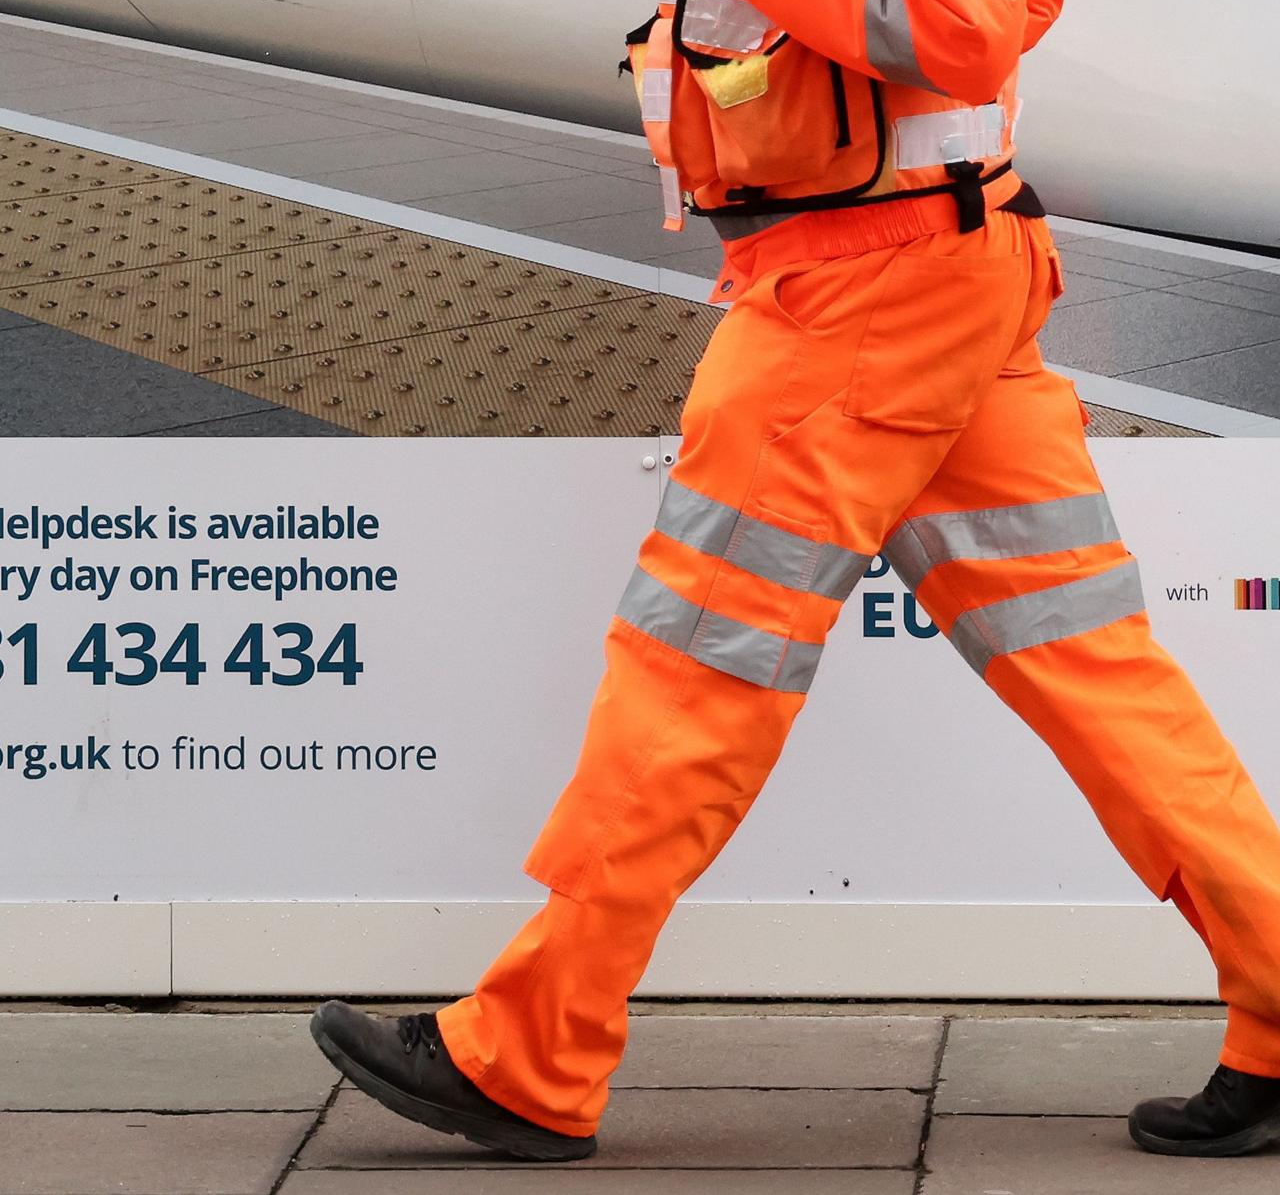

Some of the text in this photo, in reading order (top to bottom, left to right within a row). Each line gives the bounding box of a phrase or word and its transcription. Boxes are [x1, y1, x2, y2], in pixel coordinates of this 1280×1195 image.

[169, 506, 197, 540] is
[207, 506, 379, 540] available
[50, 557, 120, 601] day
[129, 565, 178, 592] on
[191, 557, 397, 601] Freephone
[1166, 583, 1208, 602] with
[67, 622, 206, 686] 434
[224, 622, 363, 686] 434
[122, 740, 159, 771] to
[172, 735, 246, 771] find
[259, 740, 323, 771] out
[337, 746, 437, 771] more
